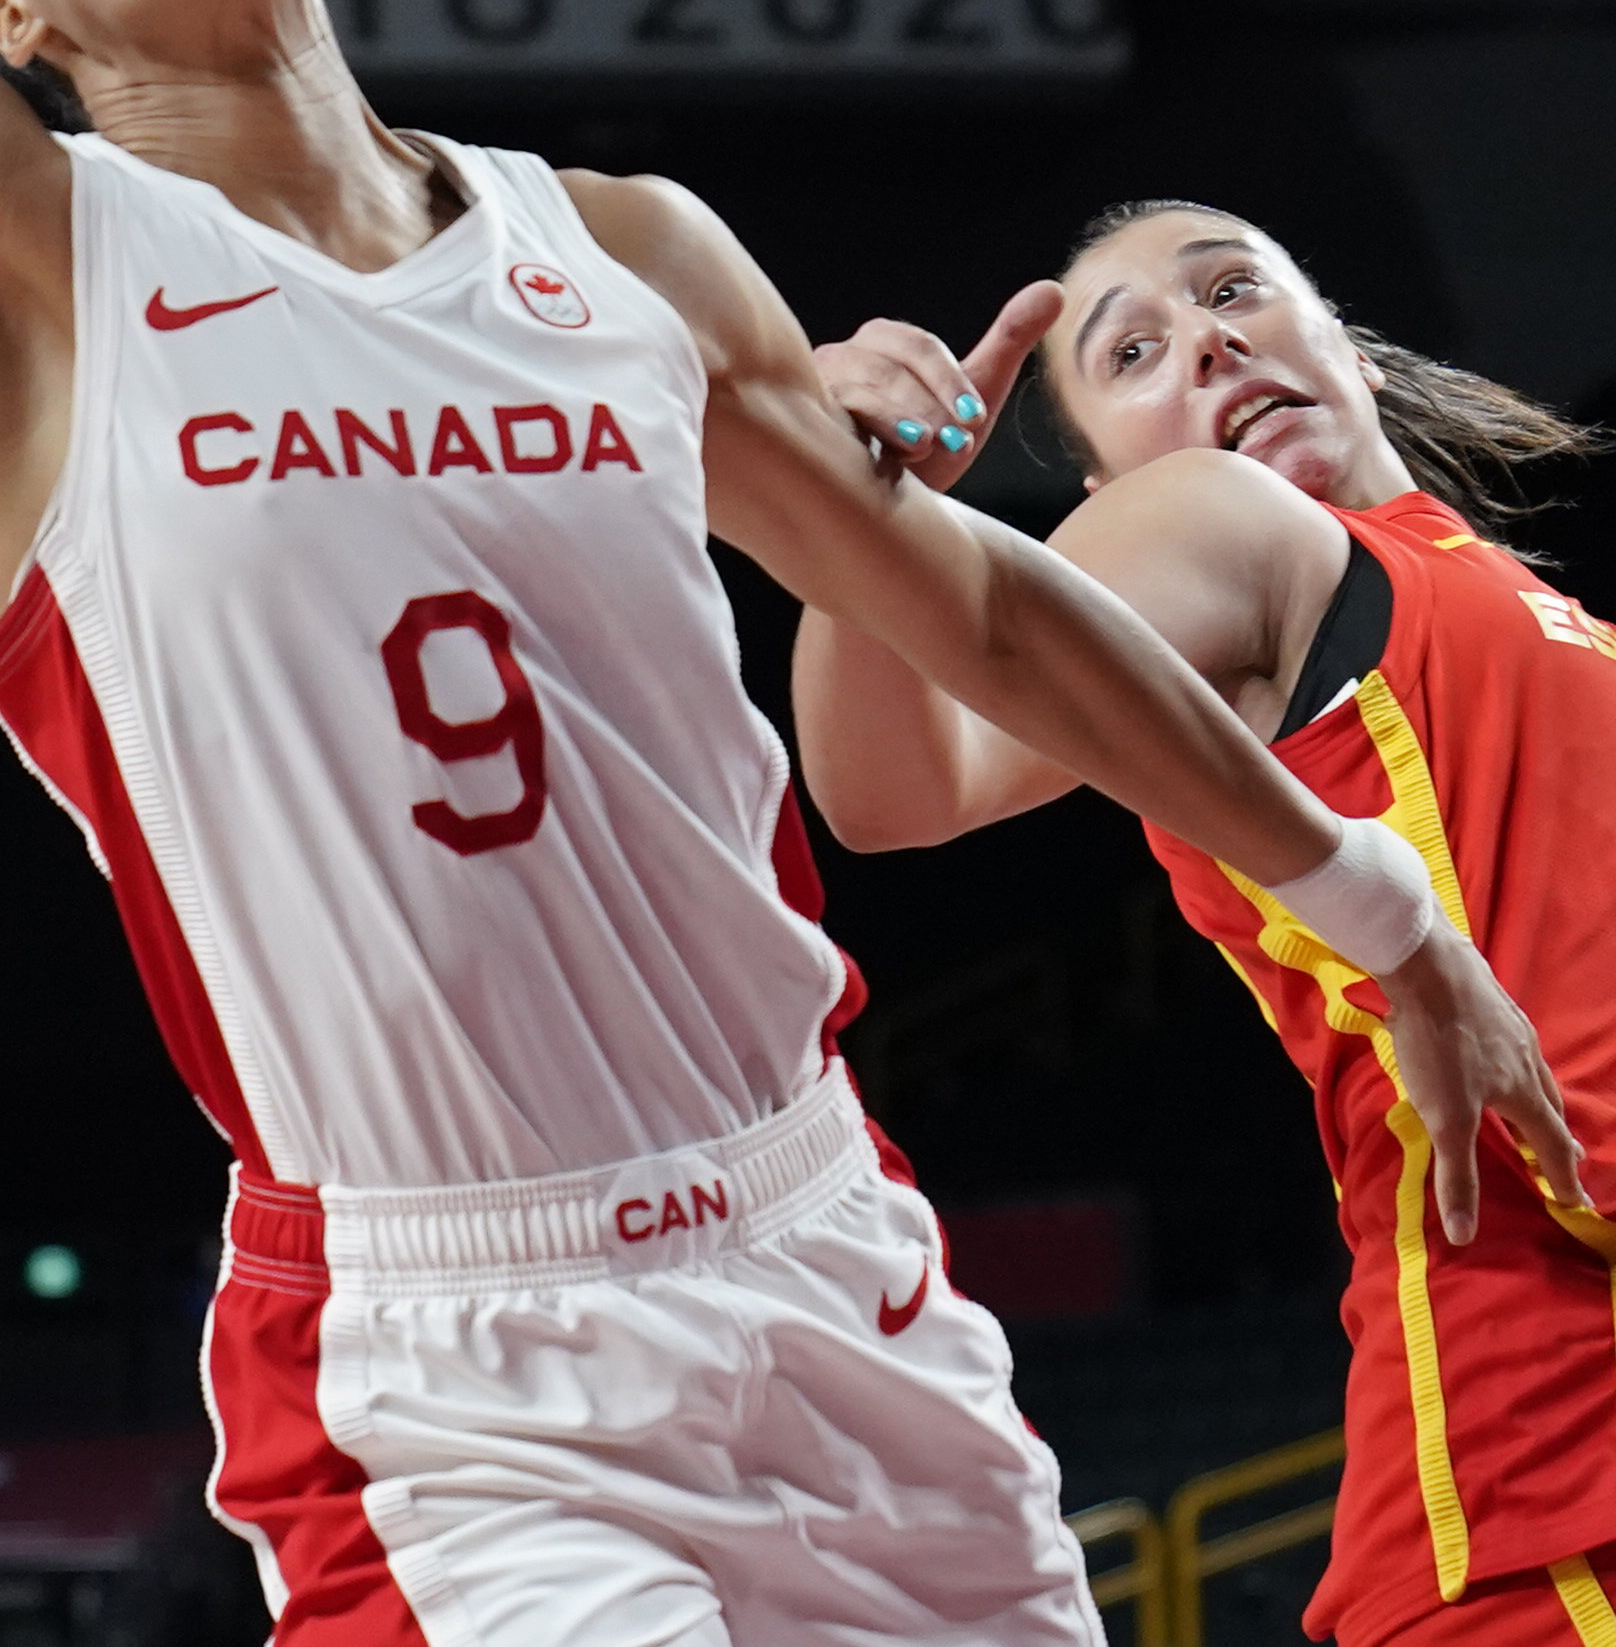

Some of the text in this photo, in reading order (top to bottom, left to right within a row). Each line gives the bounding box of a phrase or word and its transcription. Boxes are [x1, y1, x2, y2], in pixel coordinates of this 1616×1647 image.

[178, 403, 644, 487] CANADA
[381, 589, 548, 857] 9
[615, 1179, 729, 1243] CAN
